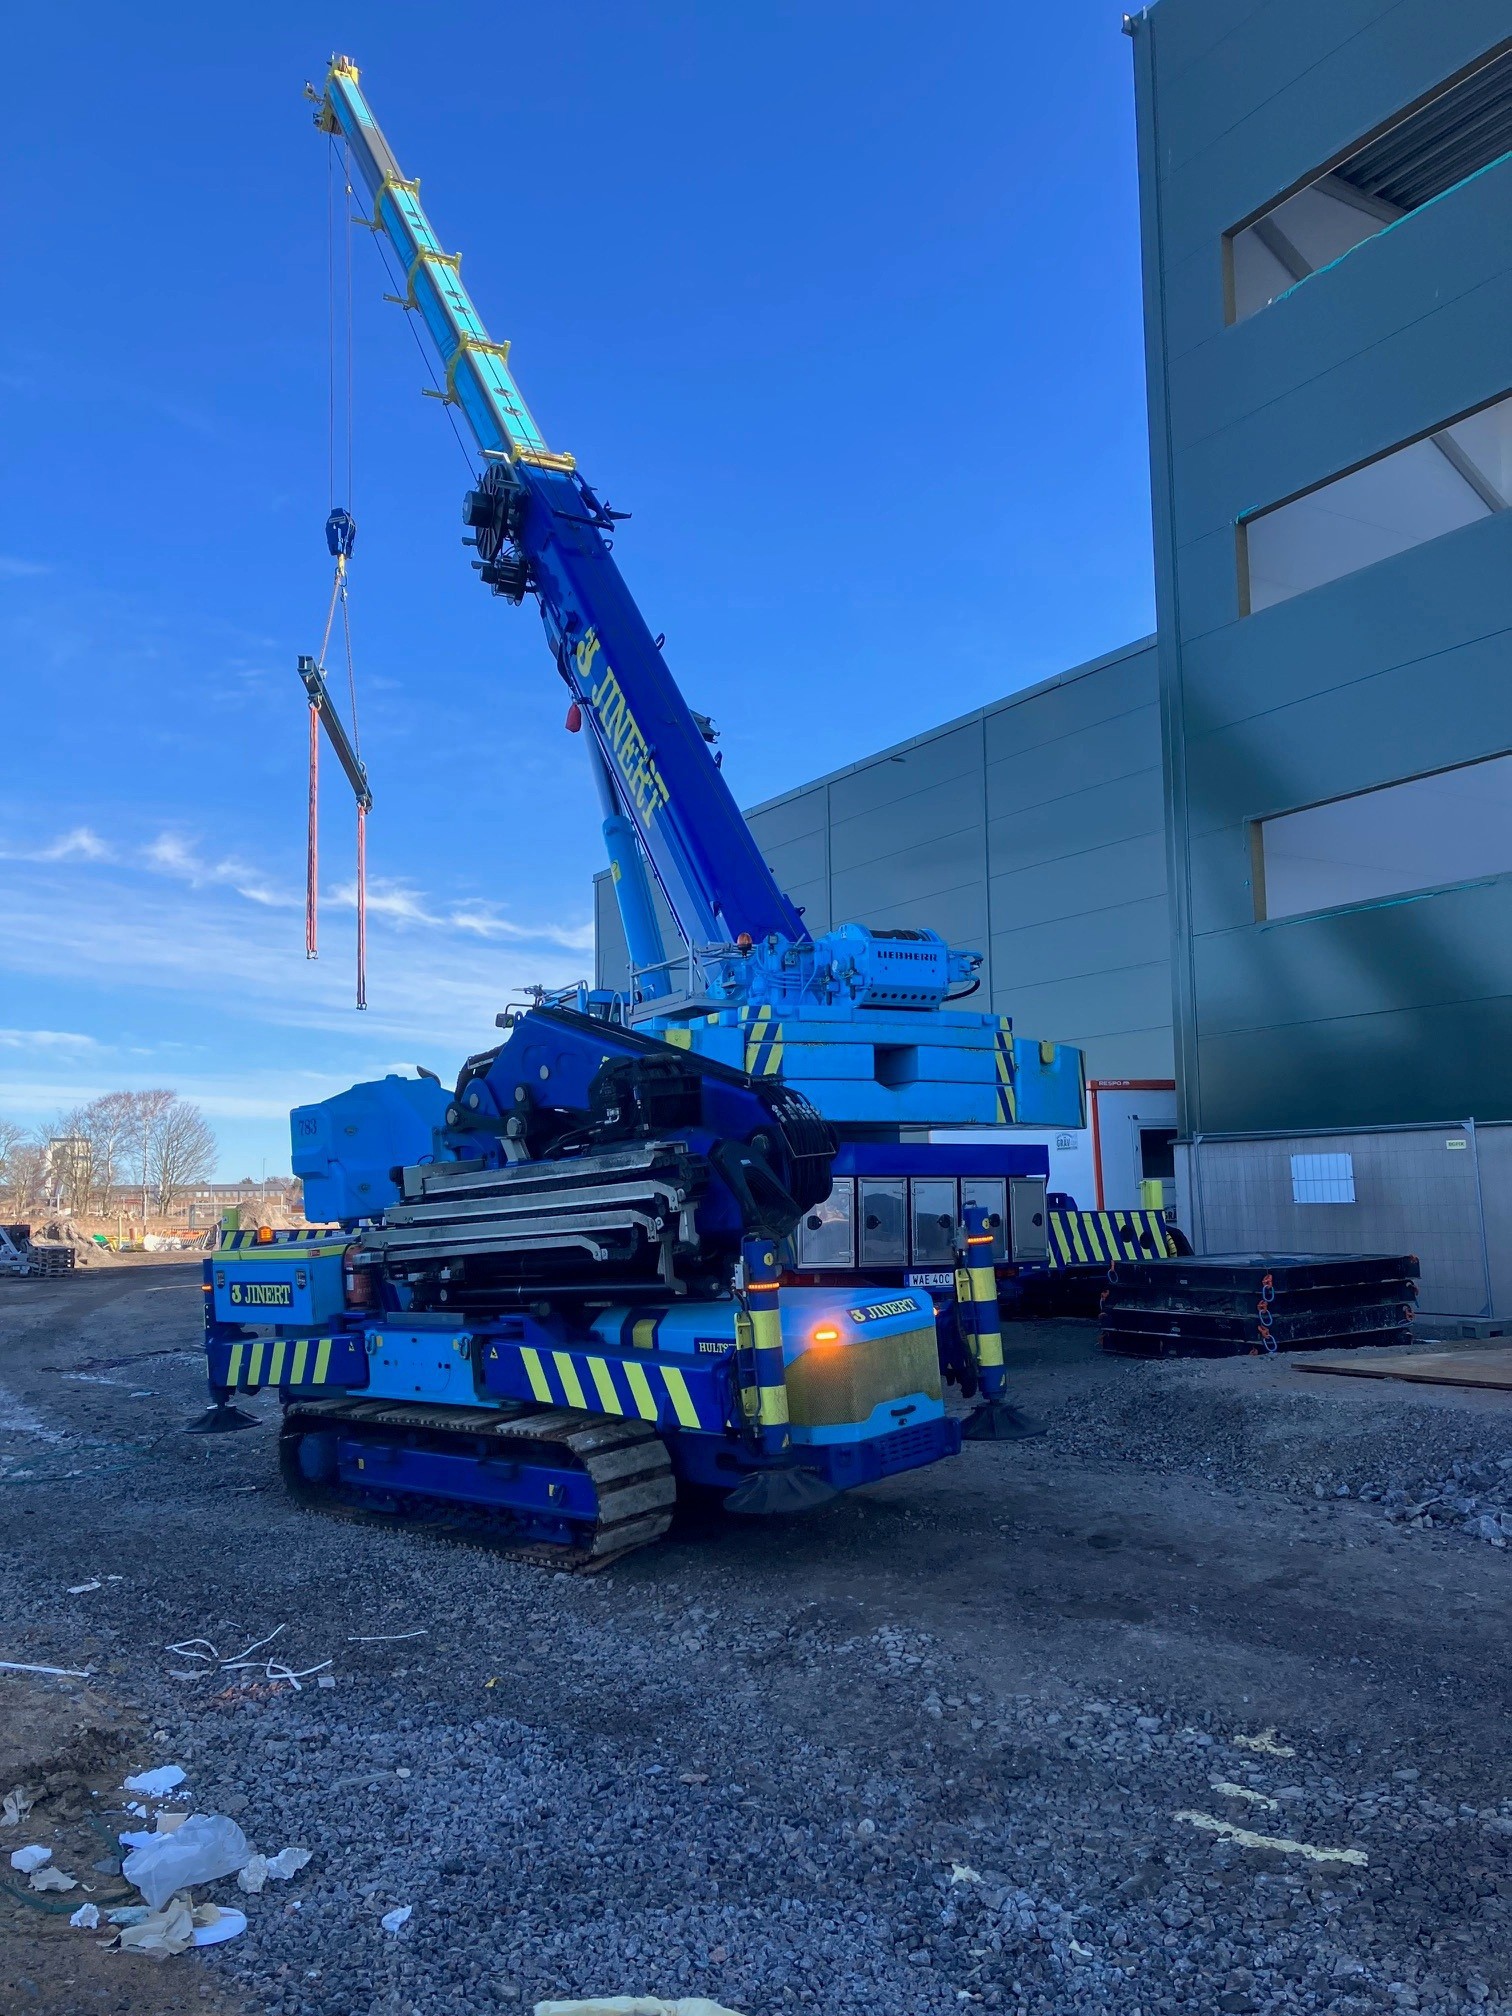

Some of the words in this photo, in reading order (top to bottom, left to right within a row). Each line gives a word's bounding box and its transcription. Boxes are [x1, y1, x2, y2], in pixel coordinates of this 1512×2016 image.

[591, 666, 671, 829] JINERT
[877, 950, 938, 962] LIEBHERR
[299, 1118, 317, 1135] 783
[912, 1274, 930, 1285] WAE
[244, 1284, 291, 1305] JINERT
[866, 1297, 917, 1319] JINERT
